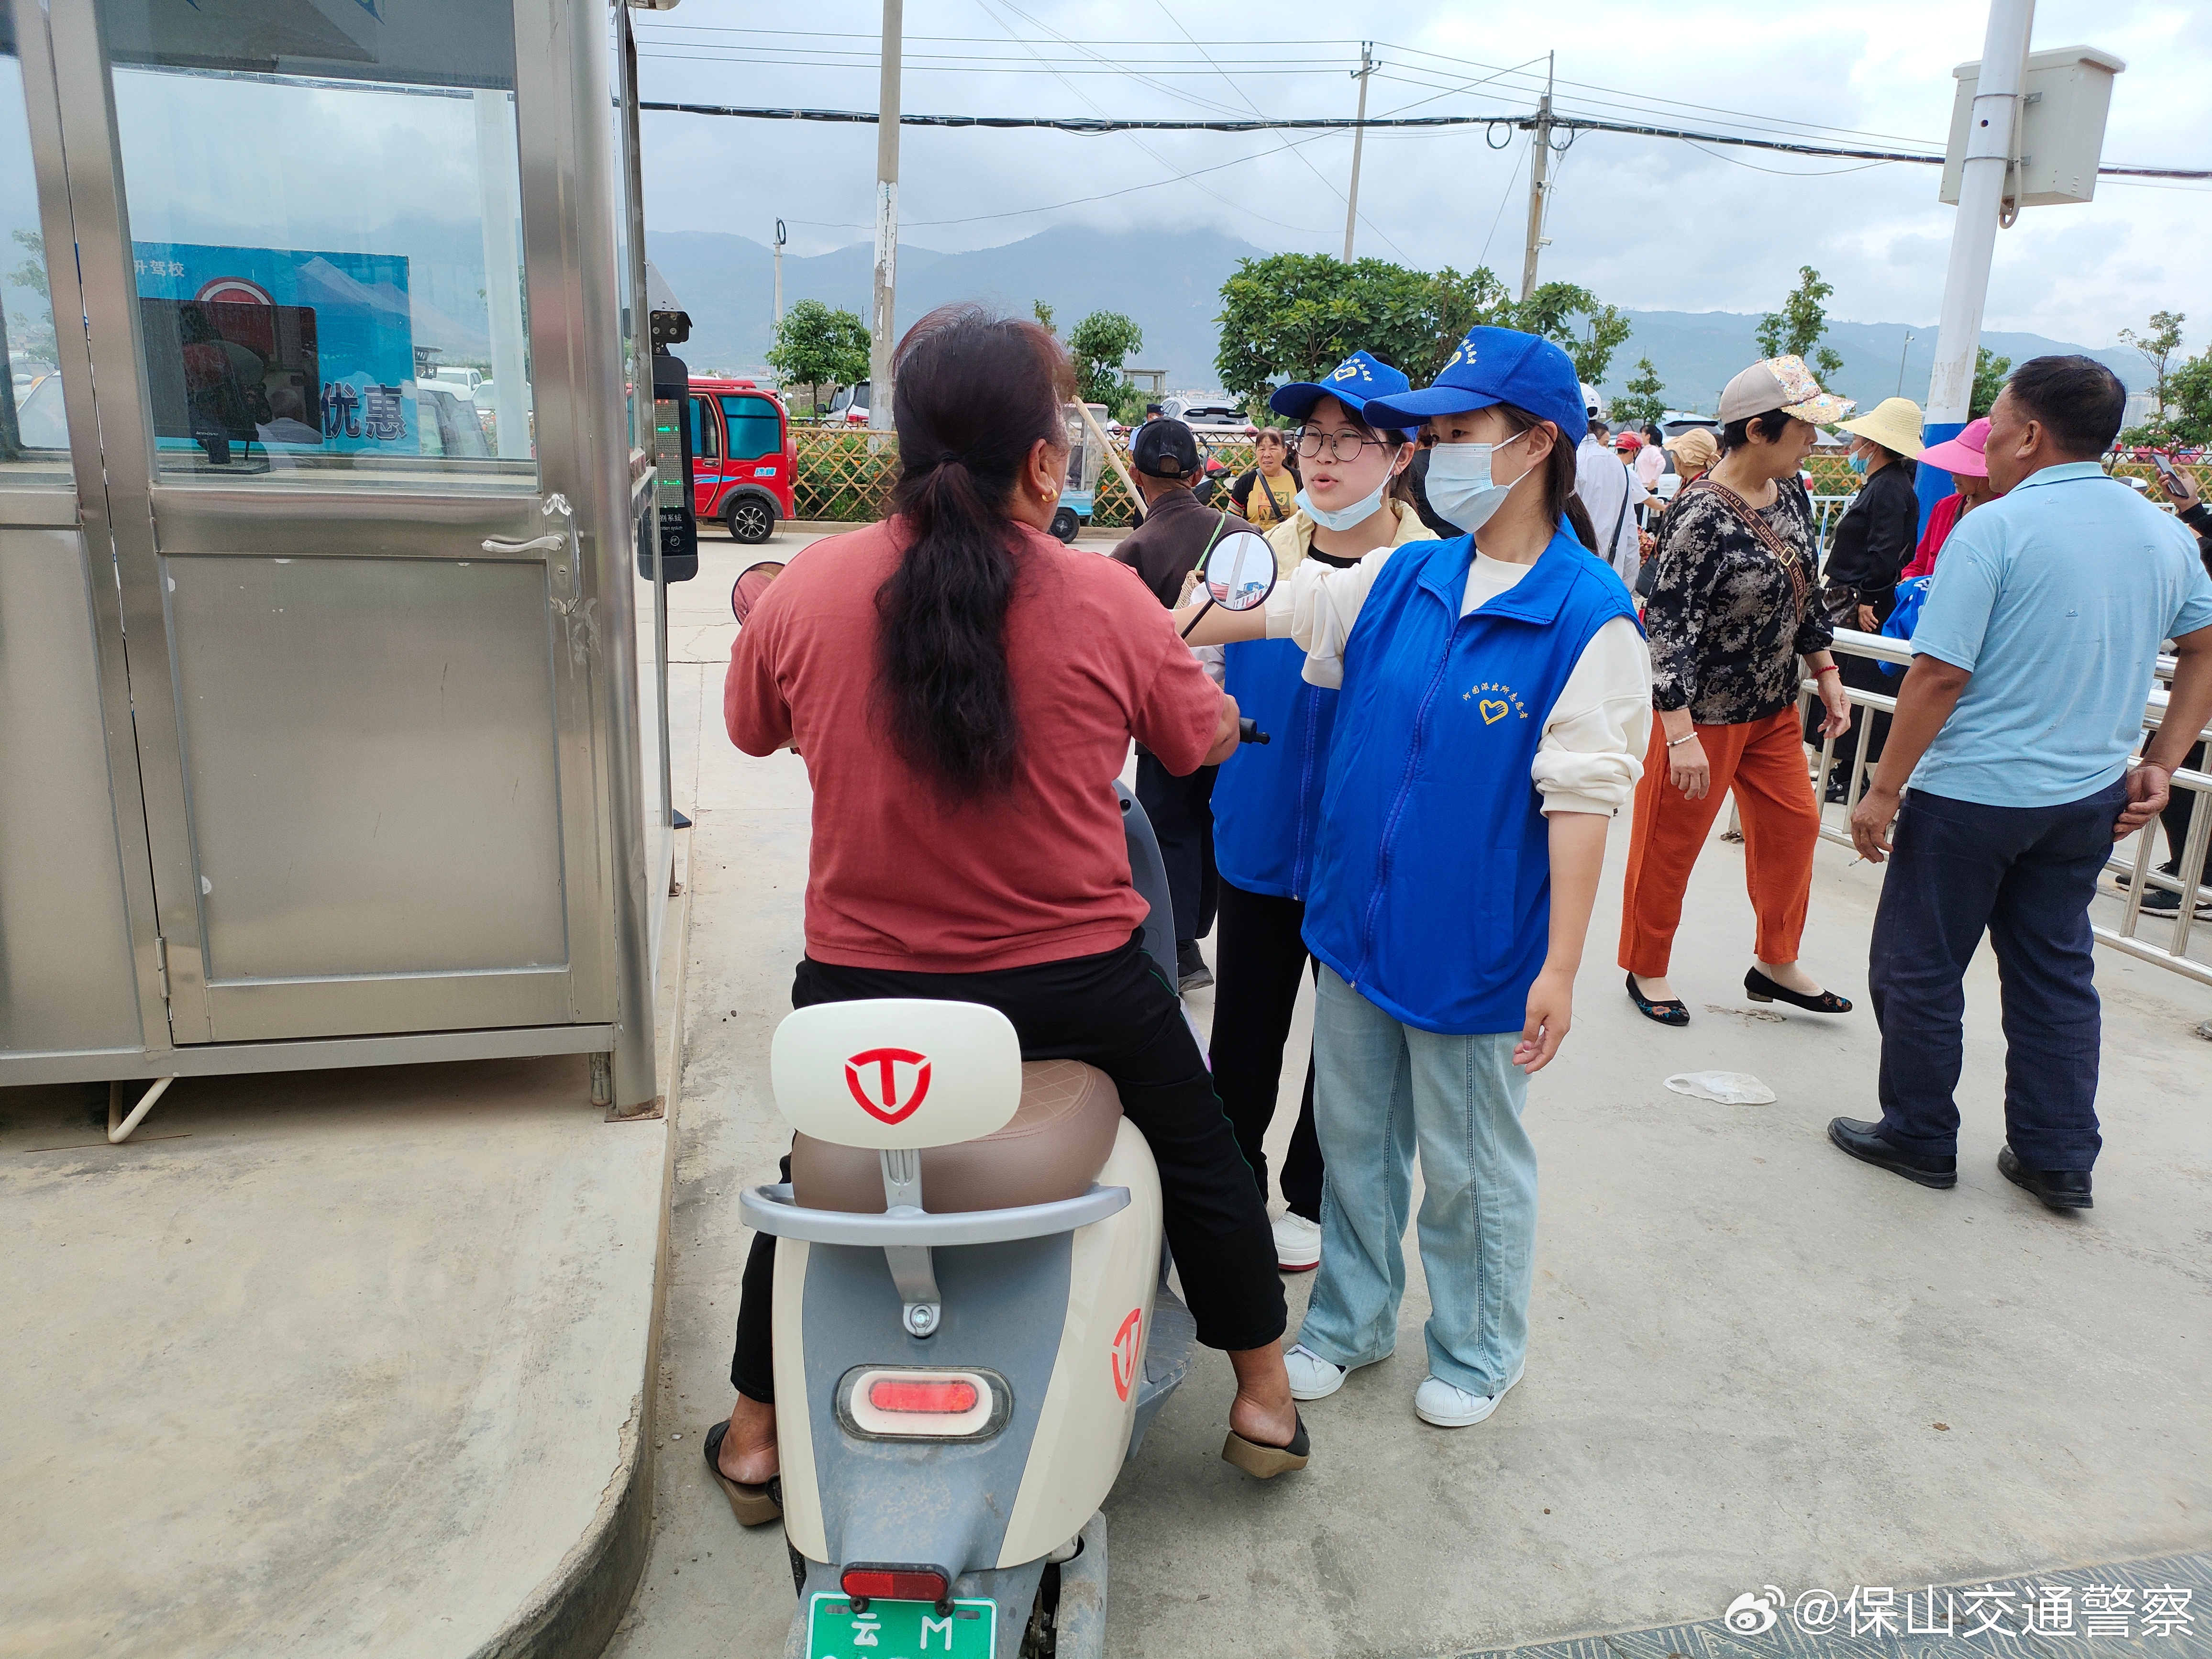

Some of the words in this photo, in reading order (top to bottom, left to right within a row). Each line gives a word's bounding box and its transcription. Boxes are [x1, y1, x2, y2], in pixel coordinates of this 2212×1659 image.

[134, 259, 185, 278] 升驾校
[321, 382, 407, 441] 优惠
[1709, 484, 1742, 507] DAISHU
[1792, 567, 1803, 596] DAISHU
[851, 1613, 881, 1646] 云
[920, 1615, 952, 1650] M
